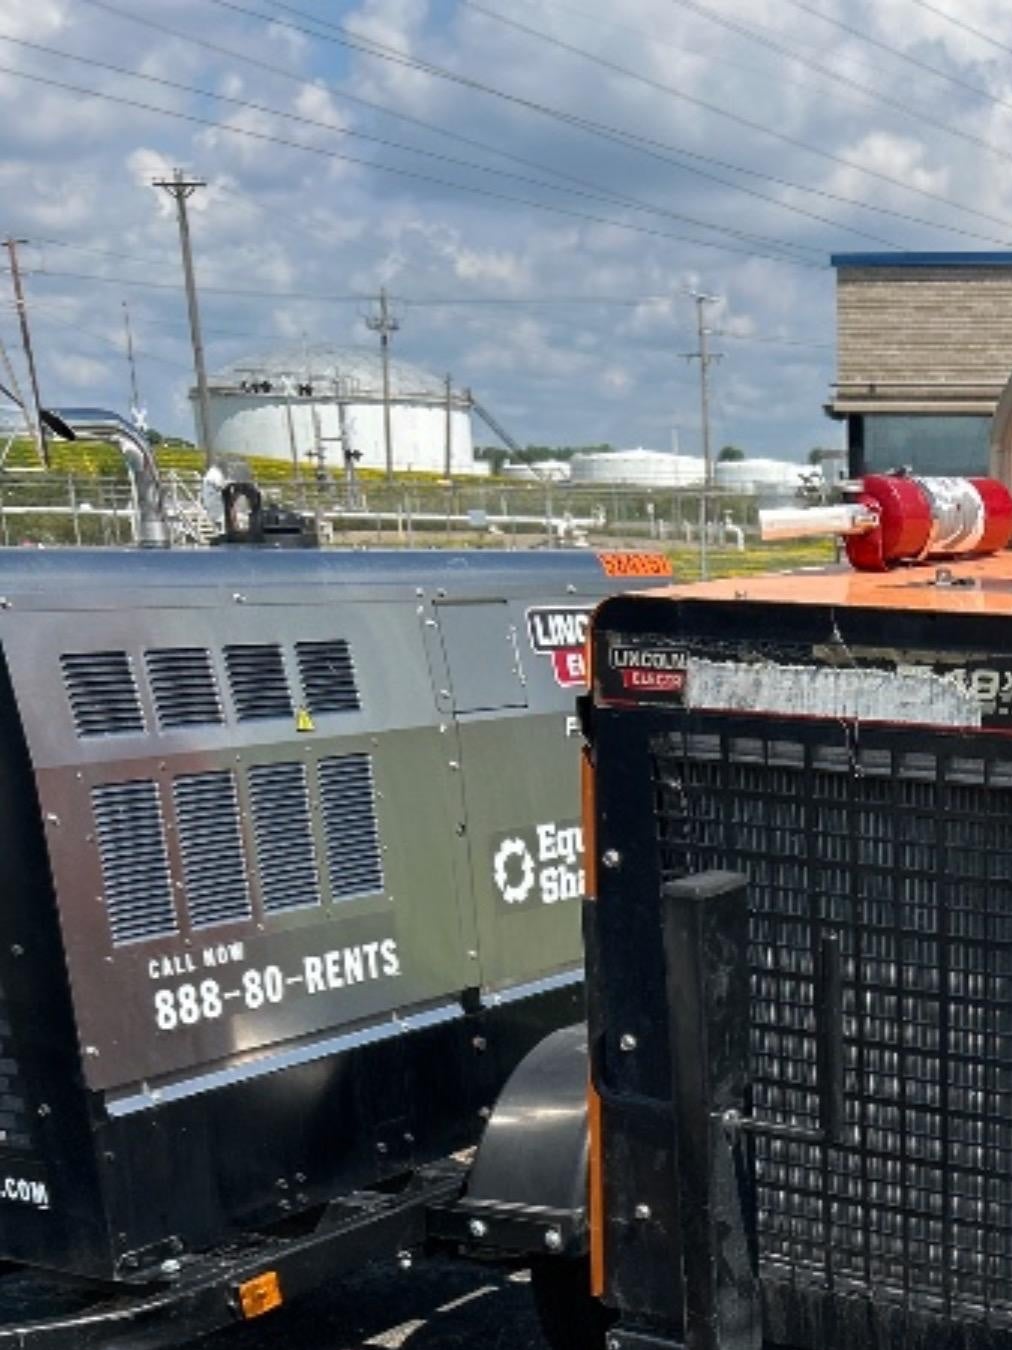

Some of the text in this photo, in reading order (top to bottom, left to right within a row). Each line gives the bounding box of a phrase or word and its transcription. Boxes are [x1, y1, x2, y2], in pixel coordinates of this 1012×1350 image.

[533, 613, 589, 645] LINC
[631, 671, 682, 687] ELECTR
[149, 941, 245, 979] CALL NOW
[154, 938, 401, 1031] 888-80-RENTS
[0, 1176, 50, 1205] .COM
